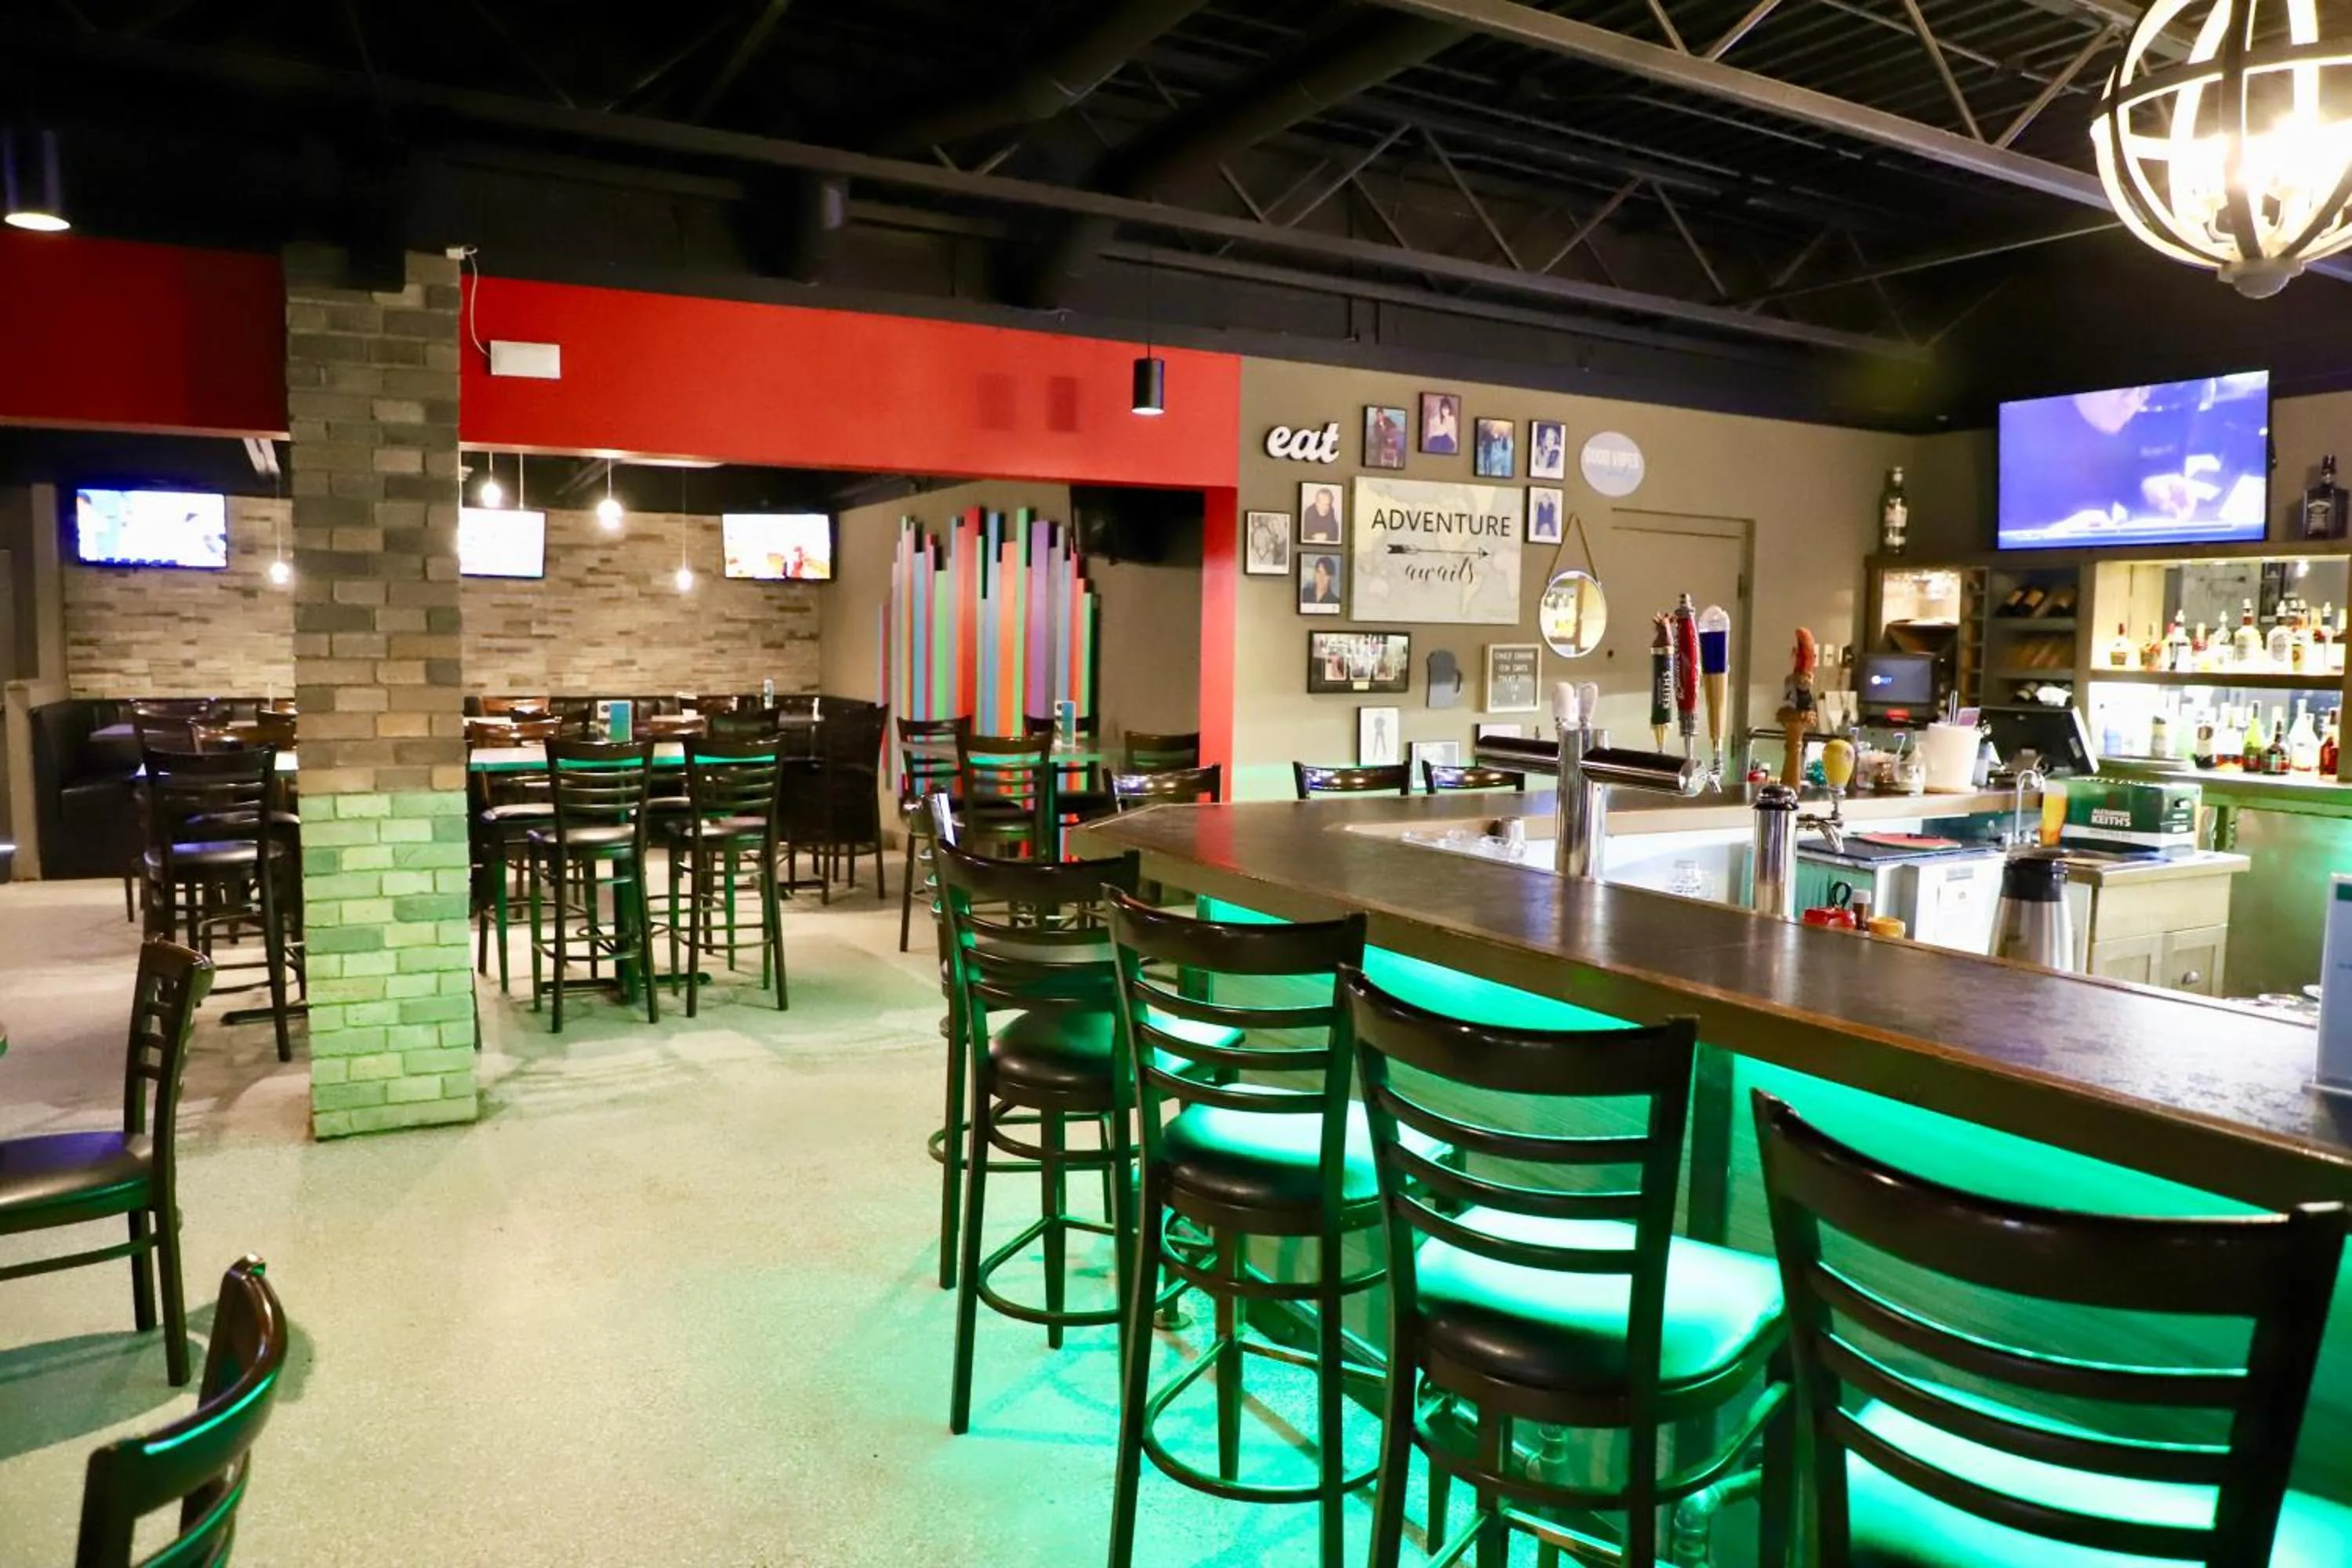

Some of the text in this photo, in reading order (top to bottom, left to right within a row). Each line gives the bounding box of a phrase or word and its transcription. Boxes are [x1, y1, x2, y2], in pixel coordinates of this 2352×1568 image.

[1265, 422, 1340, 463] eat
[1371, 508, 1512, 537] ADVENTURE
[1405, 556, 1475, 584] awaits
